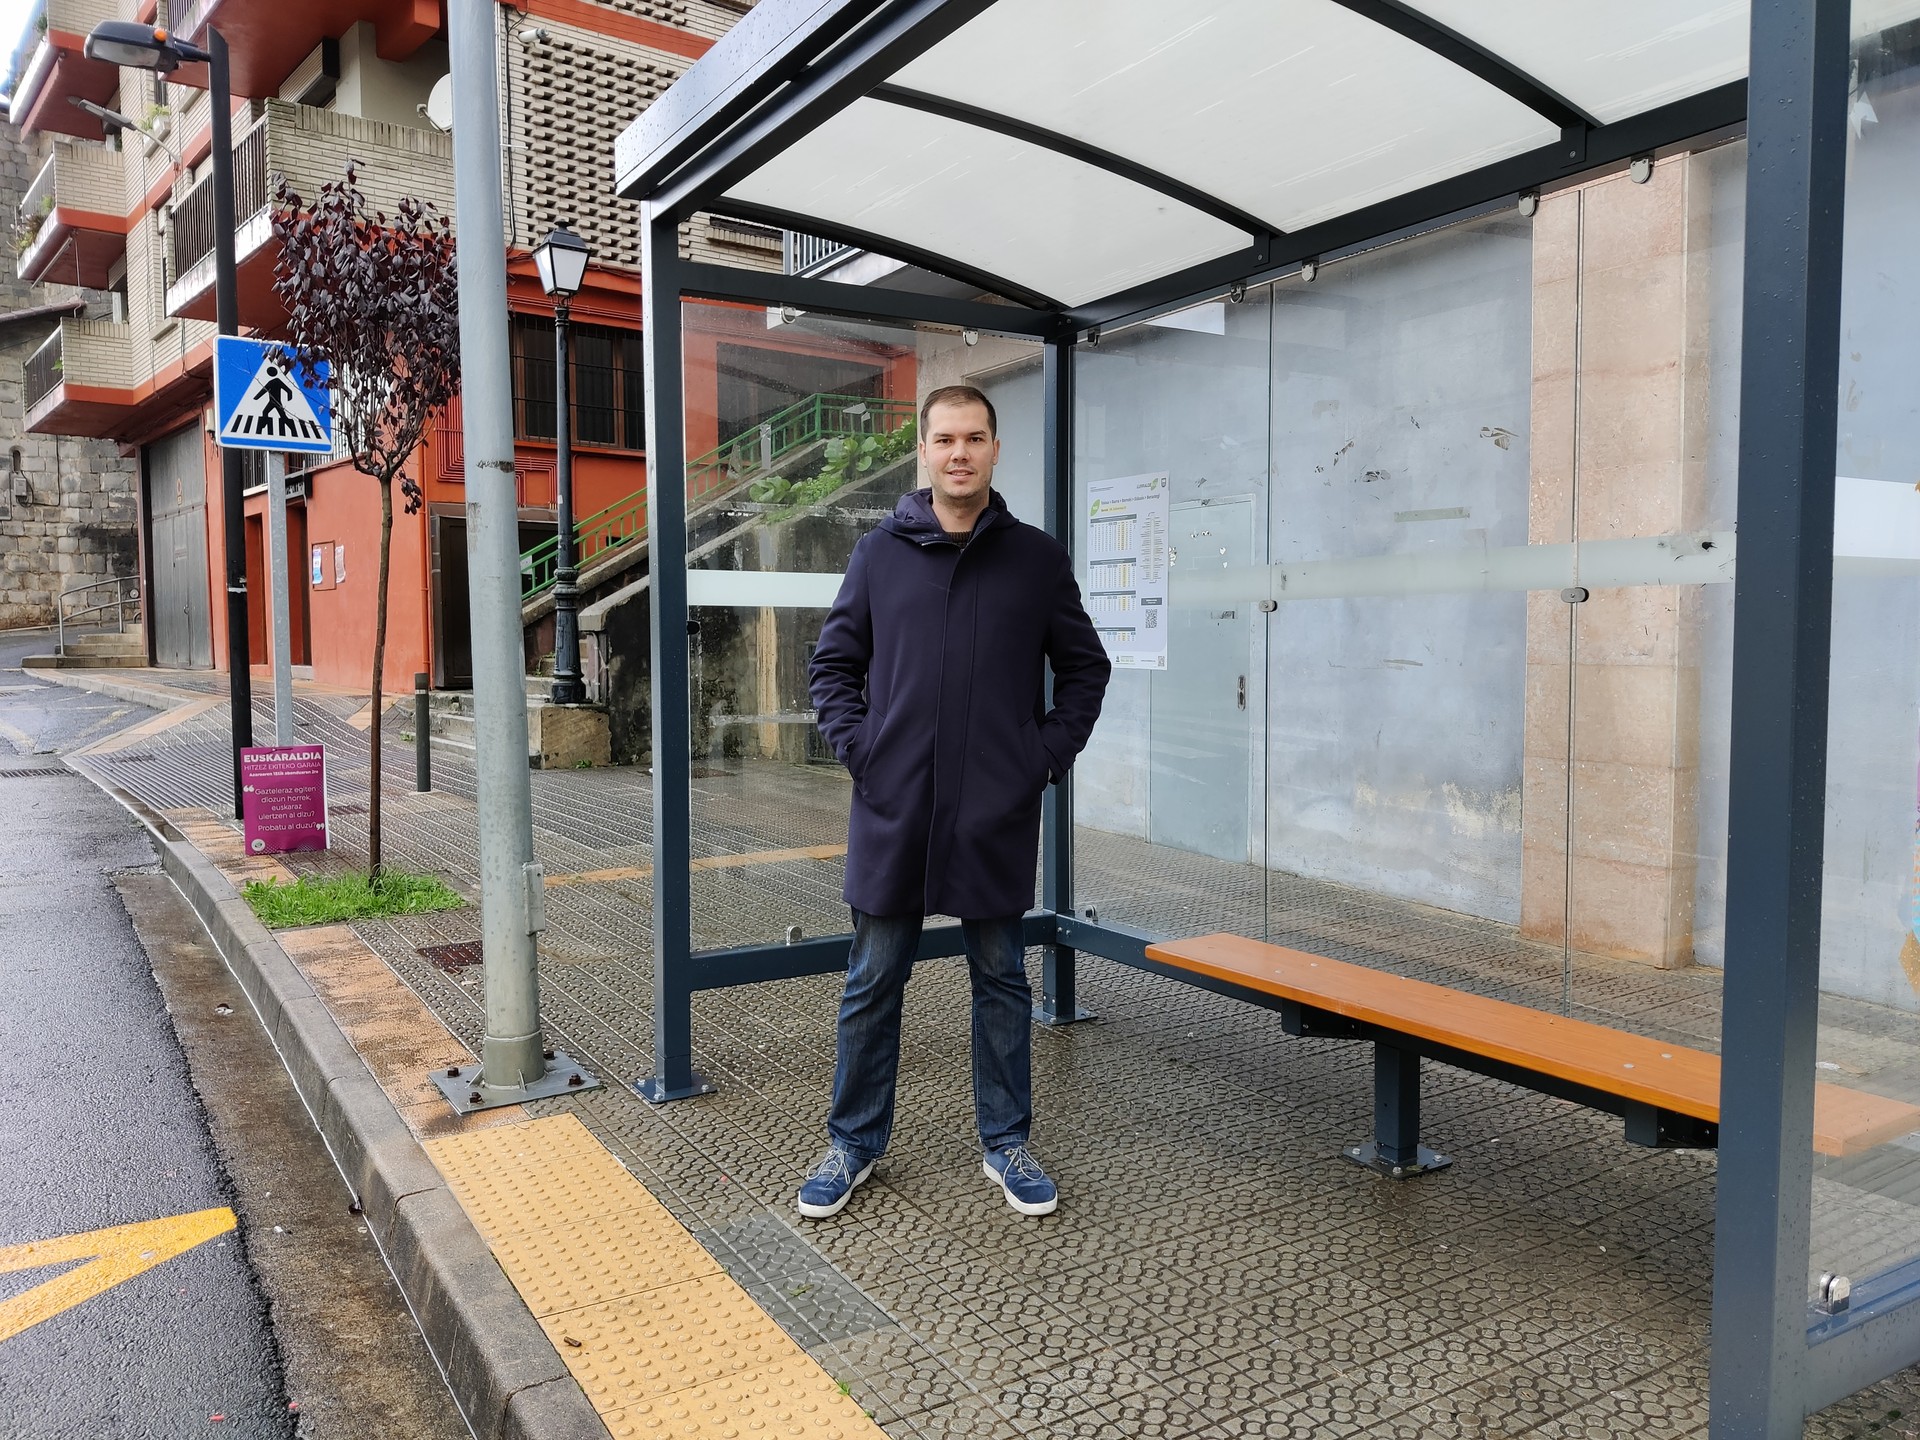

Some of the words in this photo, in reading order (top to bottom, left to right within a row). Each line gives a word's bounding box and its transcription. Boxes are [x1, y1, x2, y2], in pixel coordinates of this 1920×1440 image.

[243, 752, 322, 763] EUSKARALDIA
[294, 786, 317, 794] egiten
[258, 812, 288, 820] ulertzen
[296, 810, 315, 818] dizu?
